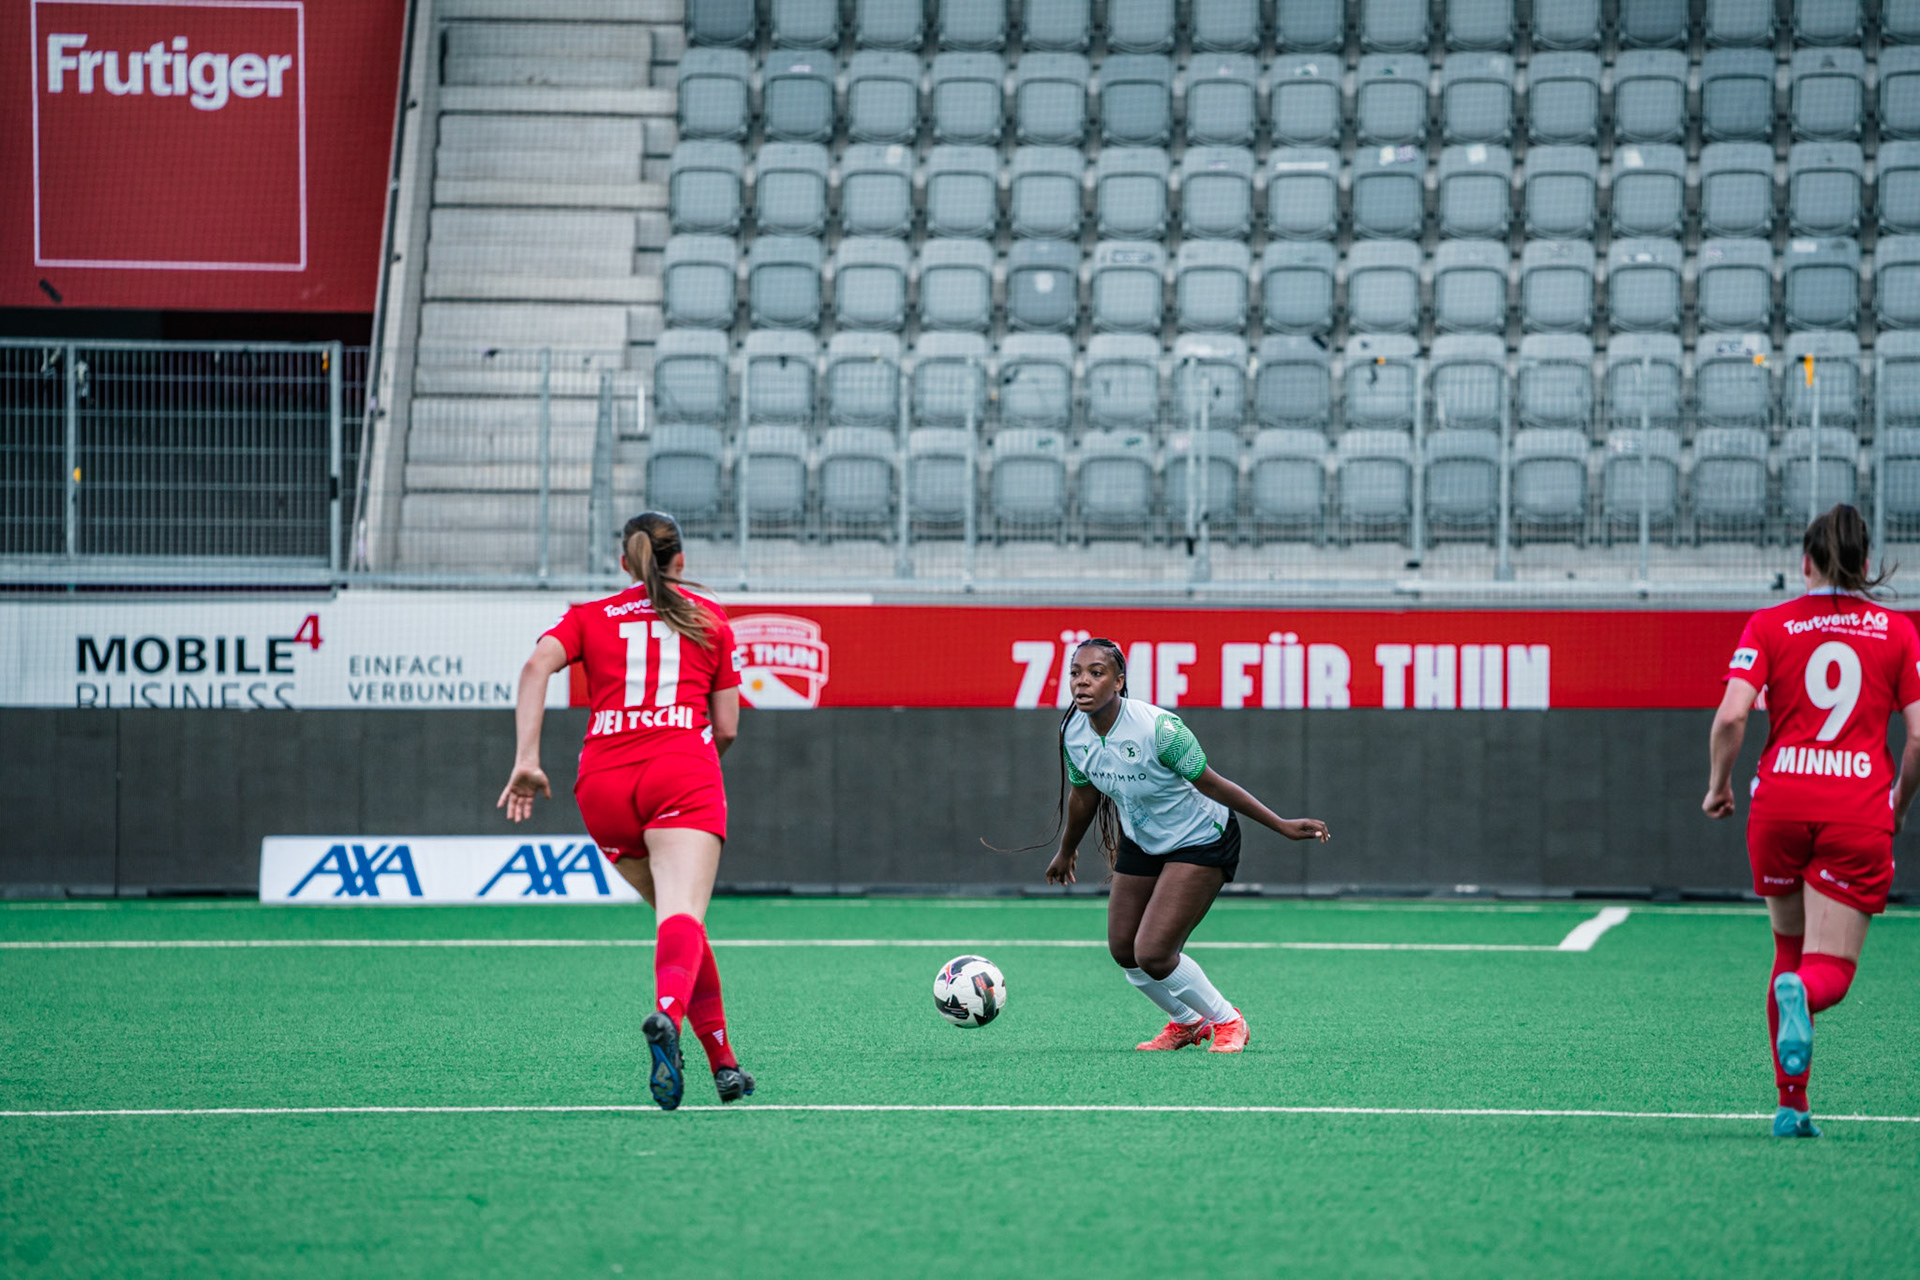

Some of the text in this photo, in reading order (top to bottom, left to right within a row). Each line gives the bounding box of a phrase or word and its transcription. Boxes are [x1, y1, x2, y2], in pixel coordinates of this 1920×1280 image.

[47, 33, 292, 111] Frutiger
[1783, 612, 1860, 635] Toutvent
[1862, 610, 1888, 626] AG
[349, 655, 463, 677] EINFACH
[619, 620, 680, 707] 11
[1222, 631, 1351, 709] FÜR
[348, 681, 512, 703] VERBUNDEN
[1805, 640, 1862, 742] 9
[1772, 747, 1872, 778] MINNIG
[288, 844, 424, 898] AXA
[477, 843, 611, 896] AXA
